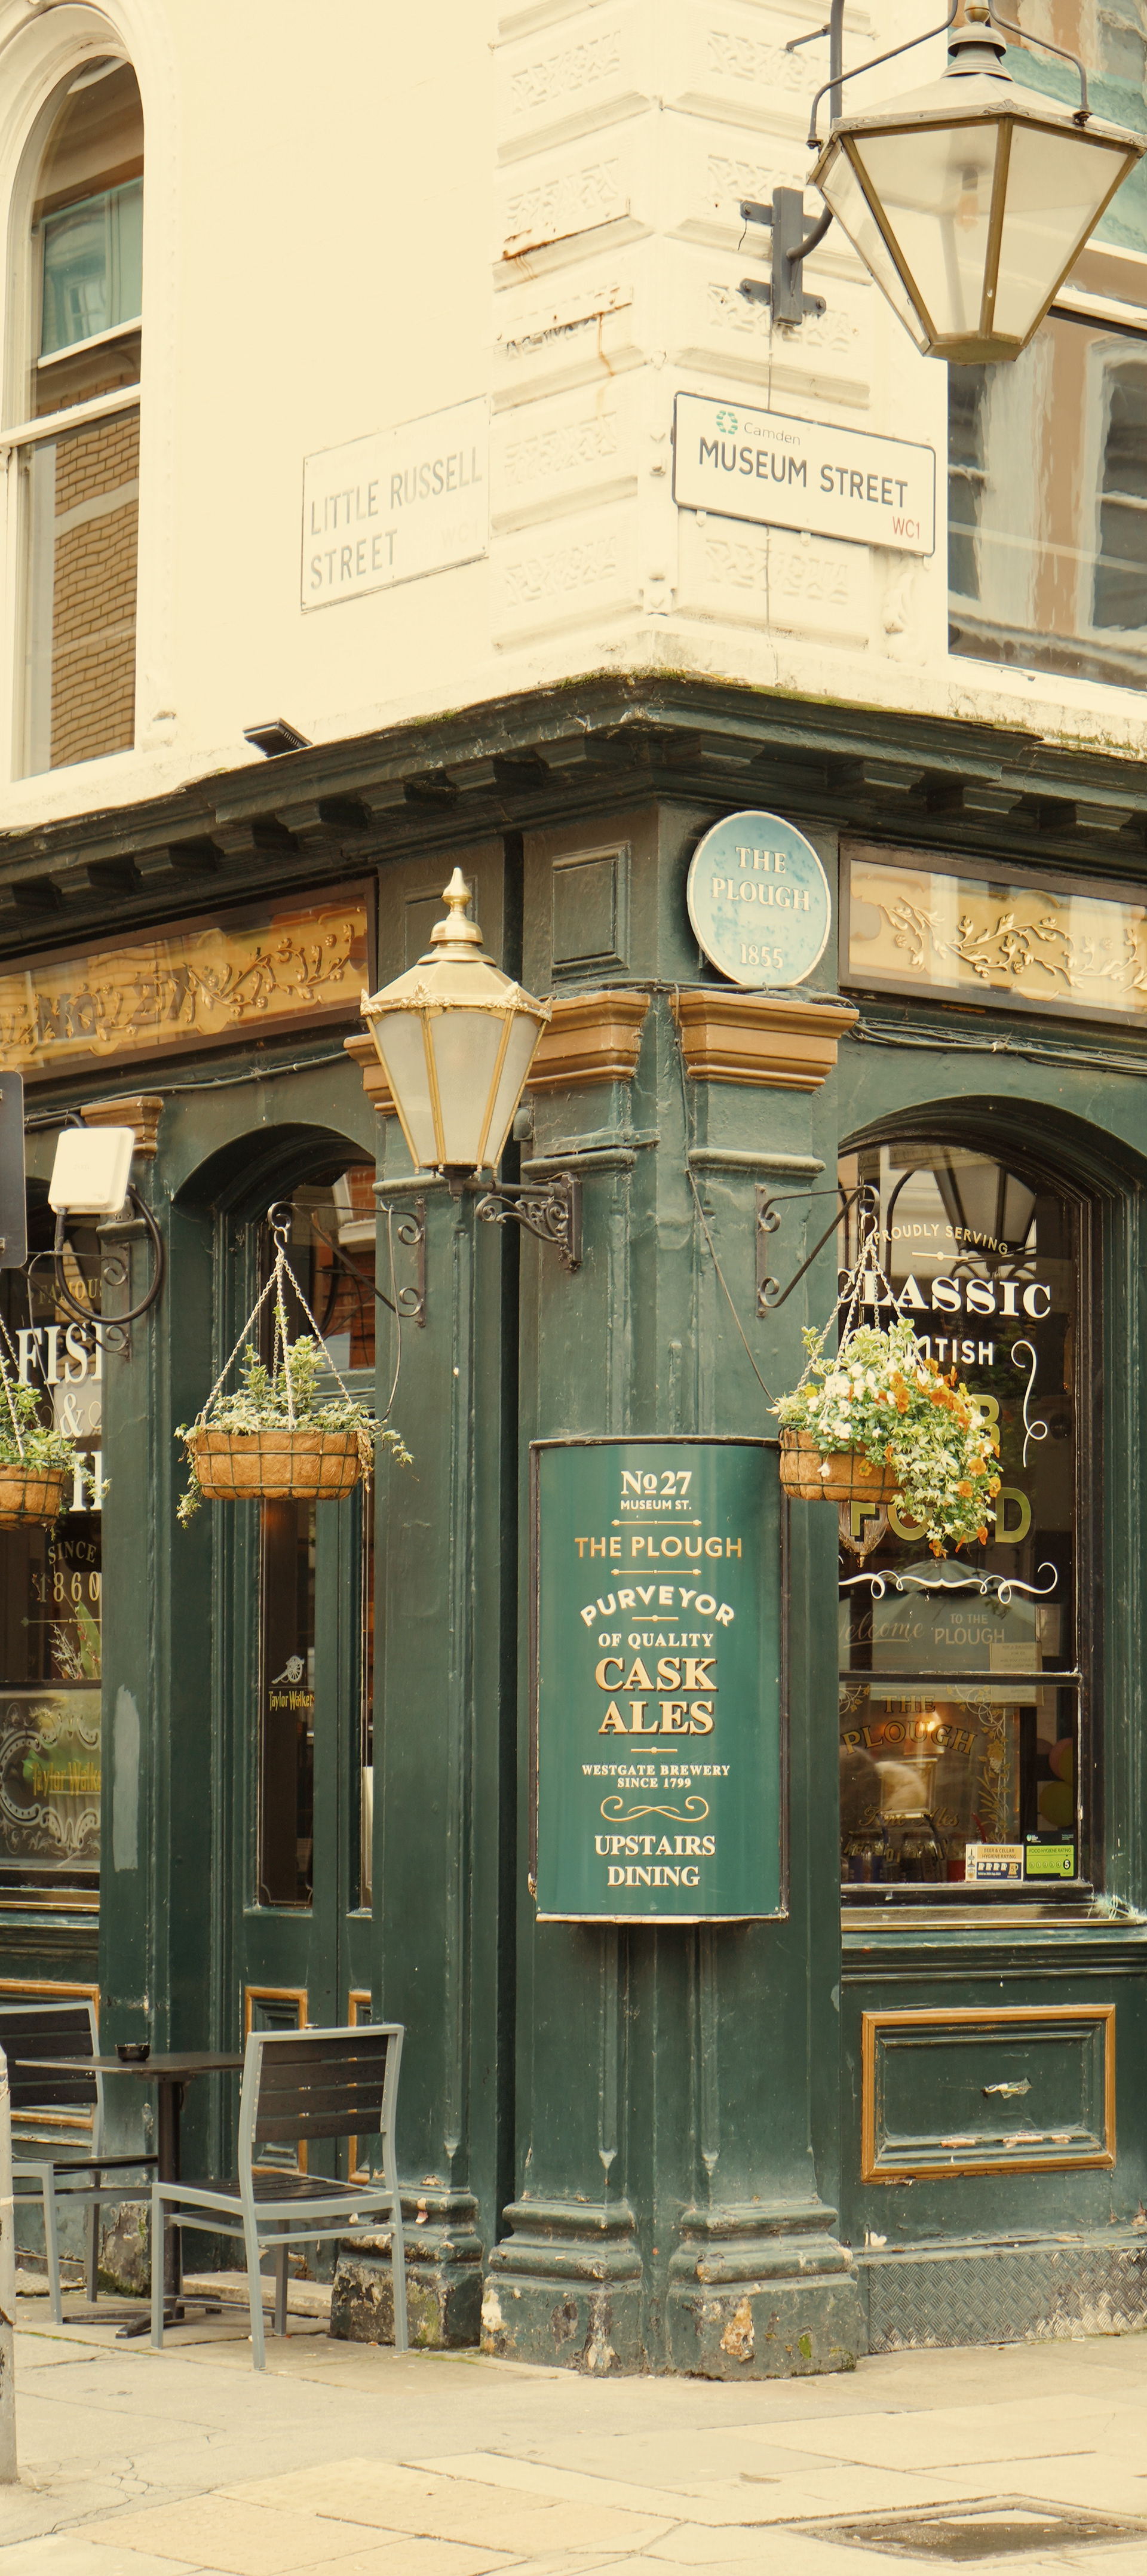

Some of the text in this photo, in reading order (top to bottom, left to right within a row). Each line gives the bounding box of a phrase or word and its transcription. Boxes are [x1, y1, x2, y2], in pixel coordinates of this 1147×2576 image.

[744, 422, 801, 446] Camden
[699, 437, 908, 508] MUSEUM STREET
[311, 446, 482, 535] LITTLE RUSSELL
[893, 515, 921, 539] WC1
[311, 529, 397, 589] STREET
[735, 846, 786, 874] THE
[711, 877, 809, 911] PLOUGH
[740, 942, 783, 969] 1855
[873, 1224, 1008, 1255] PROUDLY SERVING
[39, 1278, 102, 1304] FAMOU
[60, 1393, 84, 1439] &
[620, 1500, 692, 1510] MUSEUM ST.
[48, 1540, 97, 1565] SINCE
[575, 1536, 743, 1558] THE PLOUGH
[580, 1585, 735, 1627] PURVEYOR
[950, 1614, 964, 1625] TO
[967, 1614, 989, 1625] THE
[598, 1632, 714, 1650] OF QUALITY
[934, 1628, 1005, 1645] PLOUGH
[594, 1657, 719, 1692] CASK
[268, 1690, 313, 1711] Taylor Walker
[881, 1695, 936, 1713] THE
[598, 1701, 714, 1736] ALES
[841, 1721, 978, 1755] PLOUGH
[32, 1762, 102, 1797] Taylor Walke
[582, 1764, 730, 1777] WESTGATE BREWERY
[617, 1777, 692, 1788] SINCE 1799
[594, 1835, 716, 1856] UPSTAIRS
[607, 1865, 700, 1887] DINING
[1064, 1860, 1070, 1869] 5
